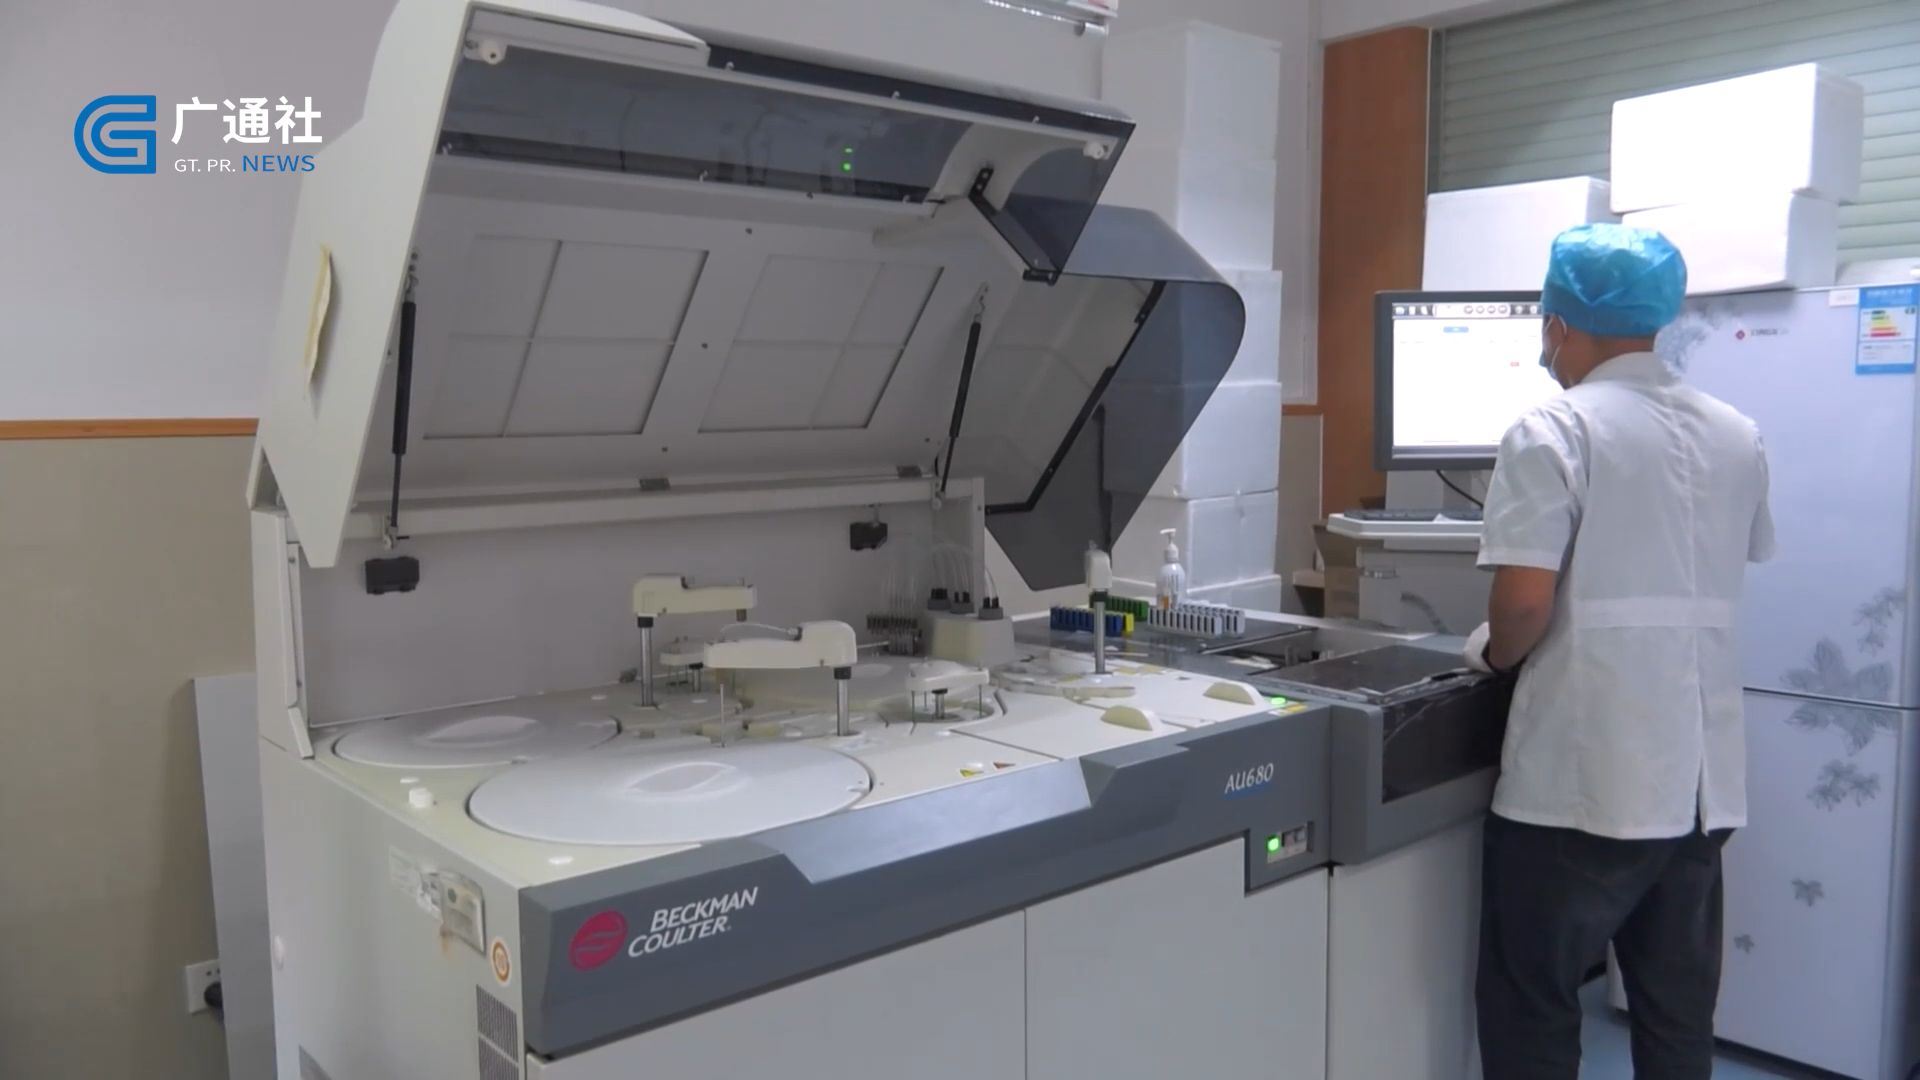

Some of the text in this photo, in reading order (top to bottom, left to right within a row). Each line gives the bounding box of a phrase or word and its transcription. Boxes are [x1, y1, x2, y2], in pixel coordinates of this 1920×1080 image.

[1224, 763, 1274, 794] AU680
[650, 886, 759, 932] BECKMAN
[628, 915, 728, 958] COULTER
